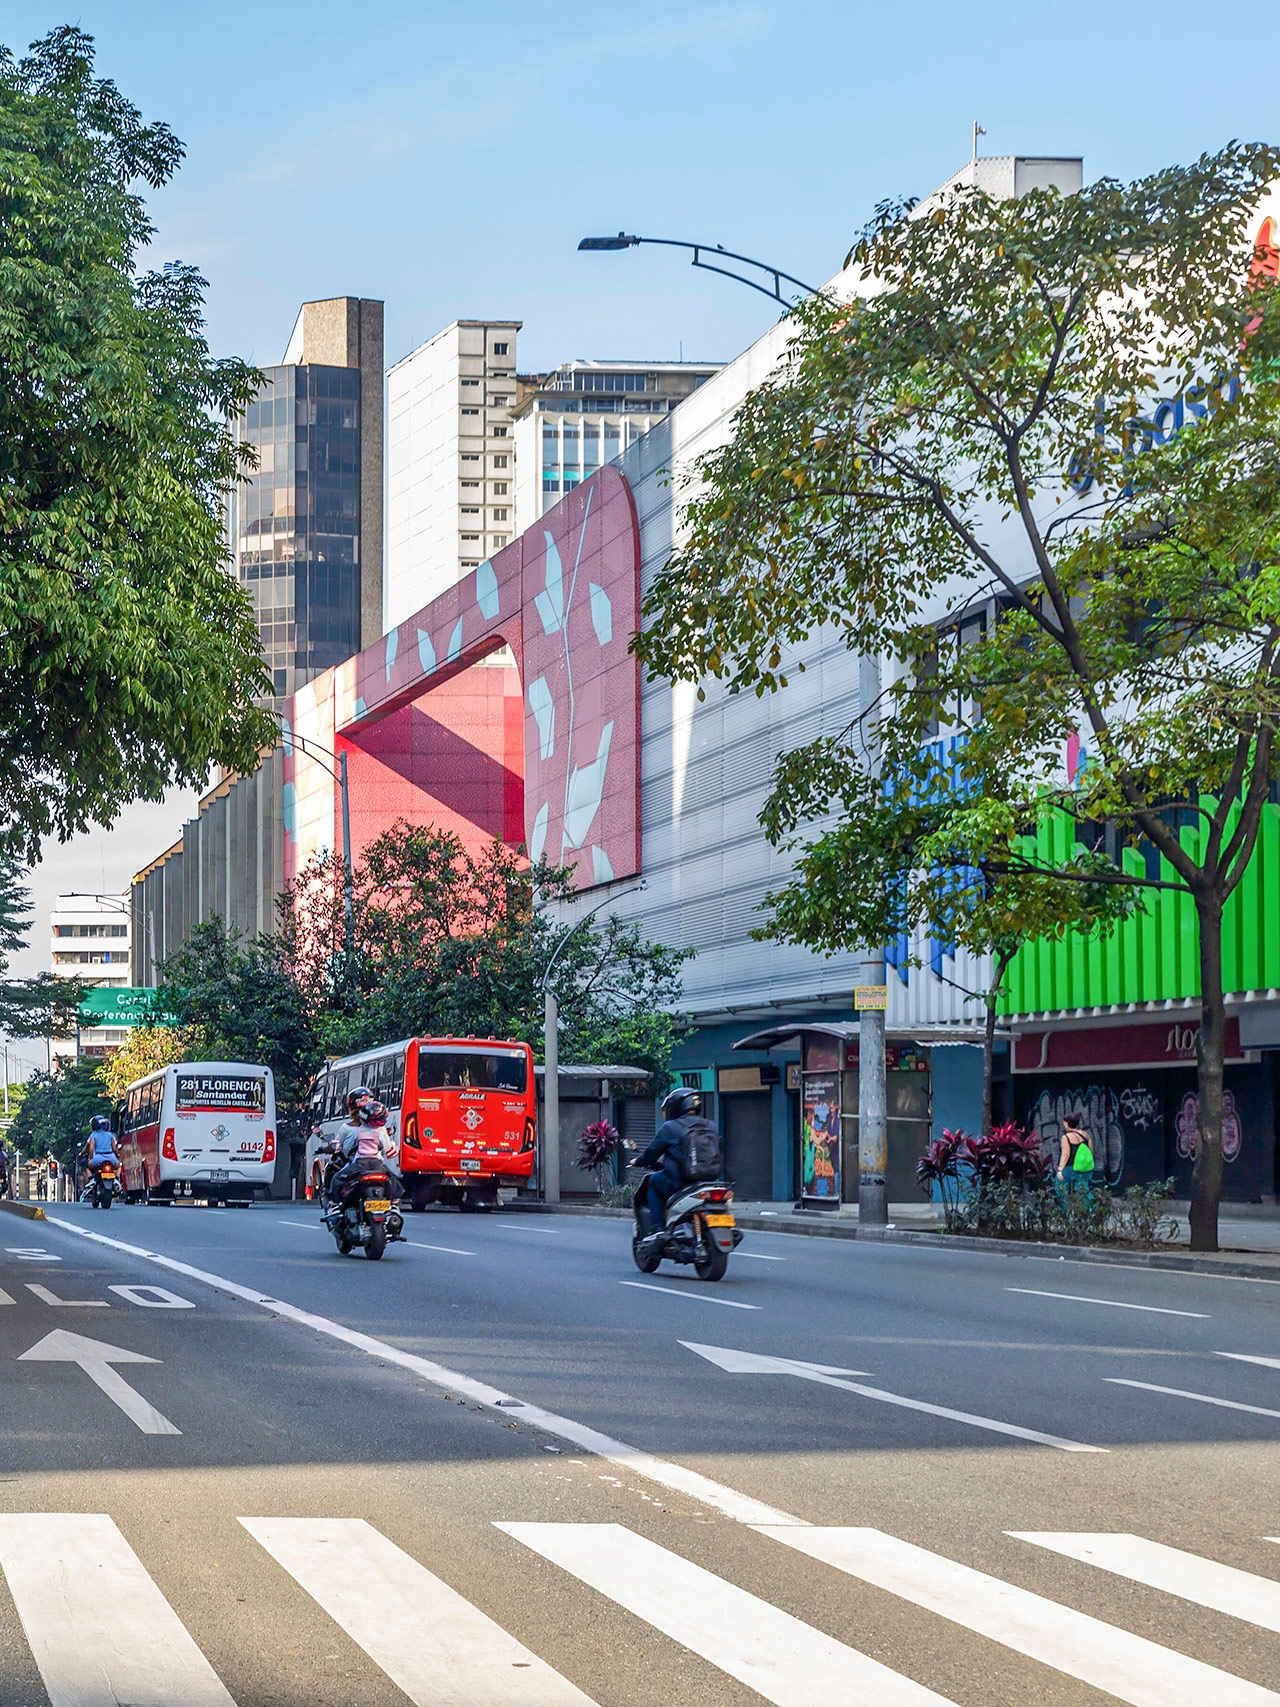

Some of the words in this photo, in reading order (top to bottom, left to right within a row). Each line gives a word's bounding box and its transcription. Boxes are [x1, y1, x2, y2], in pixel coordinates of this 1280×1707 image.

[180, 1080, 199, 1090] 281
[202, 1080, 261, 1091] FLORENCIA
[196, 1090, 247, 1100] Santander
[504, 1131, 520, 1140] 531
[240, 1142, 264, 1151] 0142
